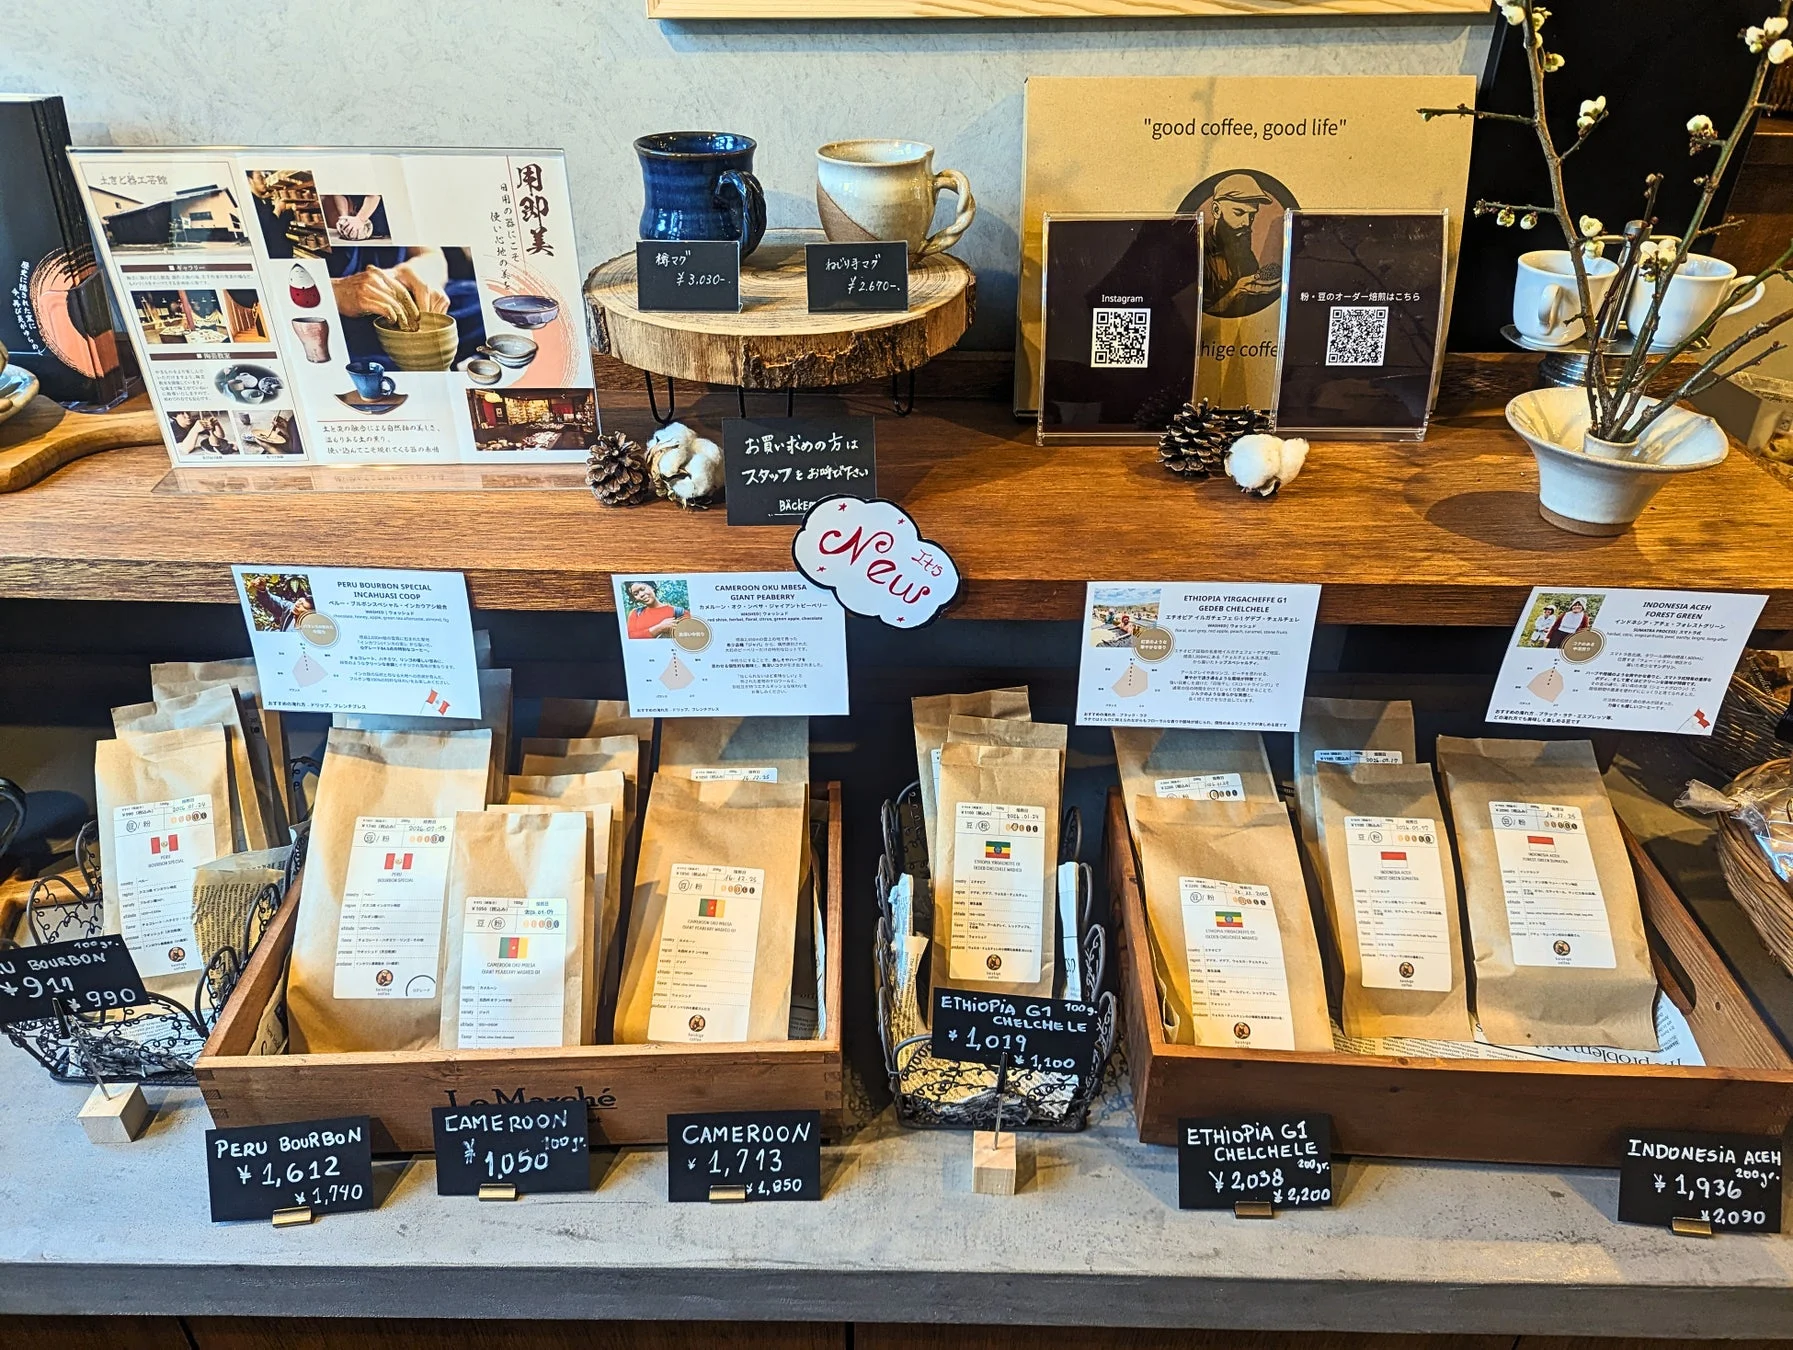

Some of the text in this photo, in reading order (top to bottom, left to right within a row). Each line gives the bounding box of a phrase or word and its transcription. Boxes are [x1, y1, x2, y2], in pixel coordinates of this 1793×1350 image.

[1144, 117, 1347, 140] "good coffee, good life"
[1101, 293, 1144, 306] Instagram
[1300, 291, 1421, 303] 粉・豆のオーダー焙煎はこちら
[744, 432, 860, 456] お買い求めの方は
[741, 464, 869, 486] スタッフをお呼び下さい
[817, 525, 932, 605] New
[336, 581, 432, 591] PERU BOURBON SPECIAL
[1222, 595, 1276, 603] YIRGACHEFFE
[1642, 601, 1688, 610] INDONESIA
[1645, 611, 1703, 620] FOREST GREEN
[27, 952, 107, 972] BOURBON
[992, 1015, 1088, 1033] CHELCHELE
[445, 1109, 568, 1133] CAMEROON
[1281, 1120, 1308, 1140] G1
[215, 1125, 362, 1160] PERU BOURBON
[681, 1120, 812, 1146] CAMEROON
[1214, 1141, 1319, 1162] CHELCHELE
[1743, 1150, 1782, 1166] ACEH
